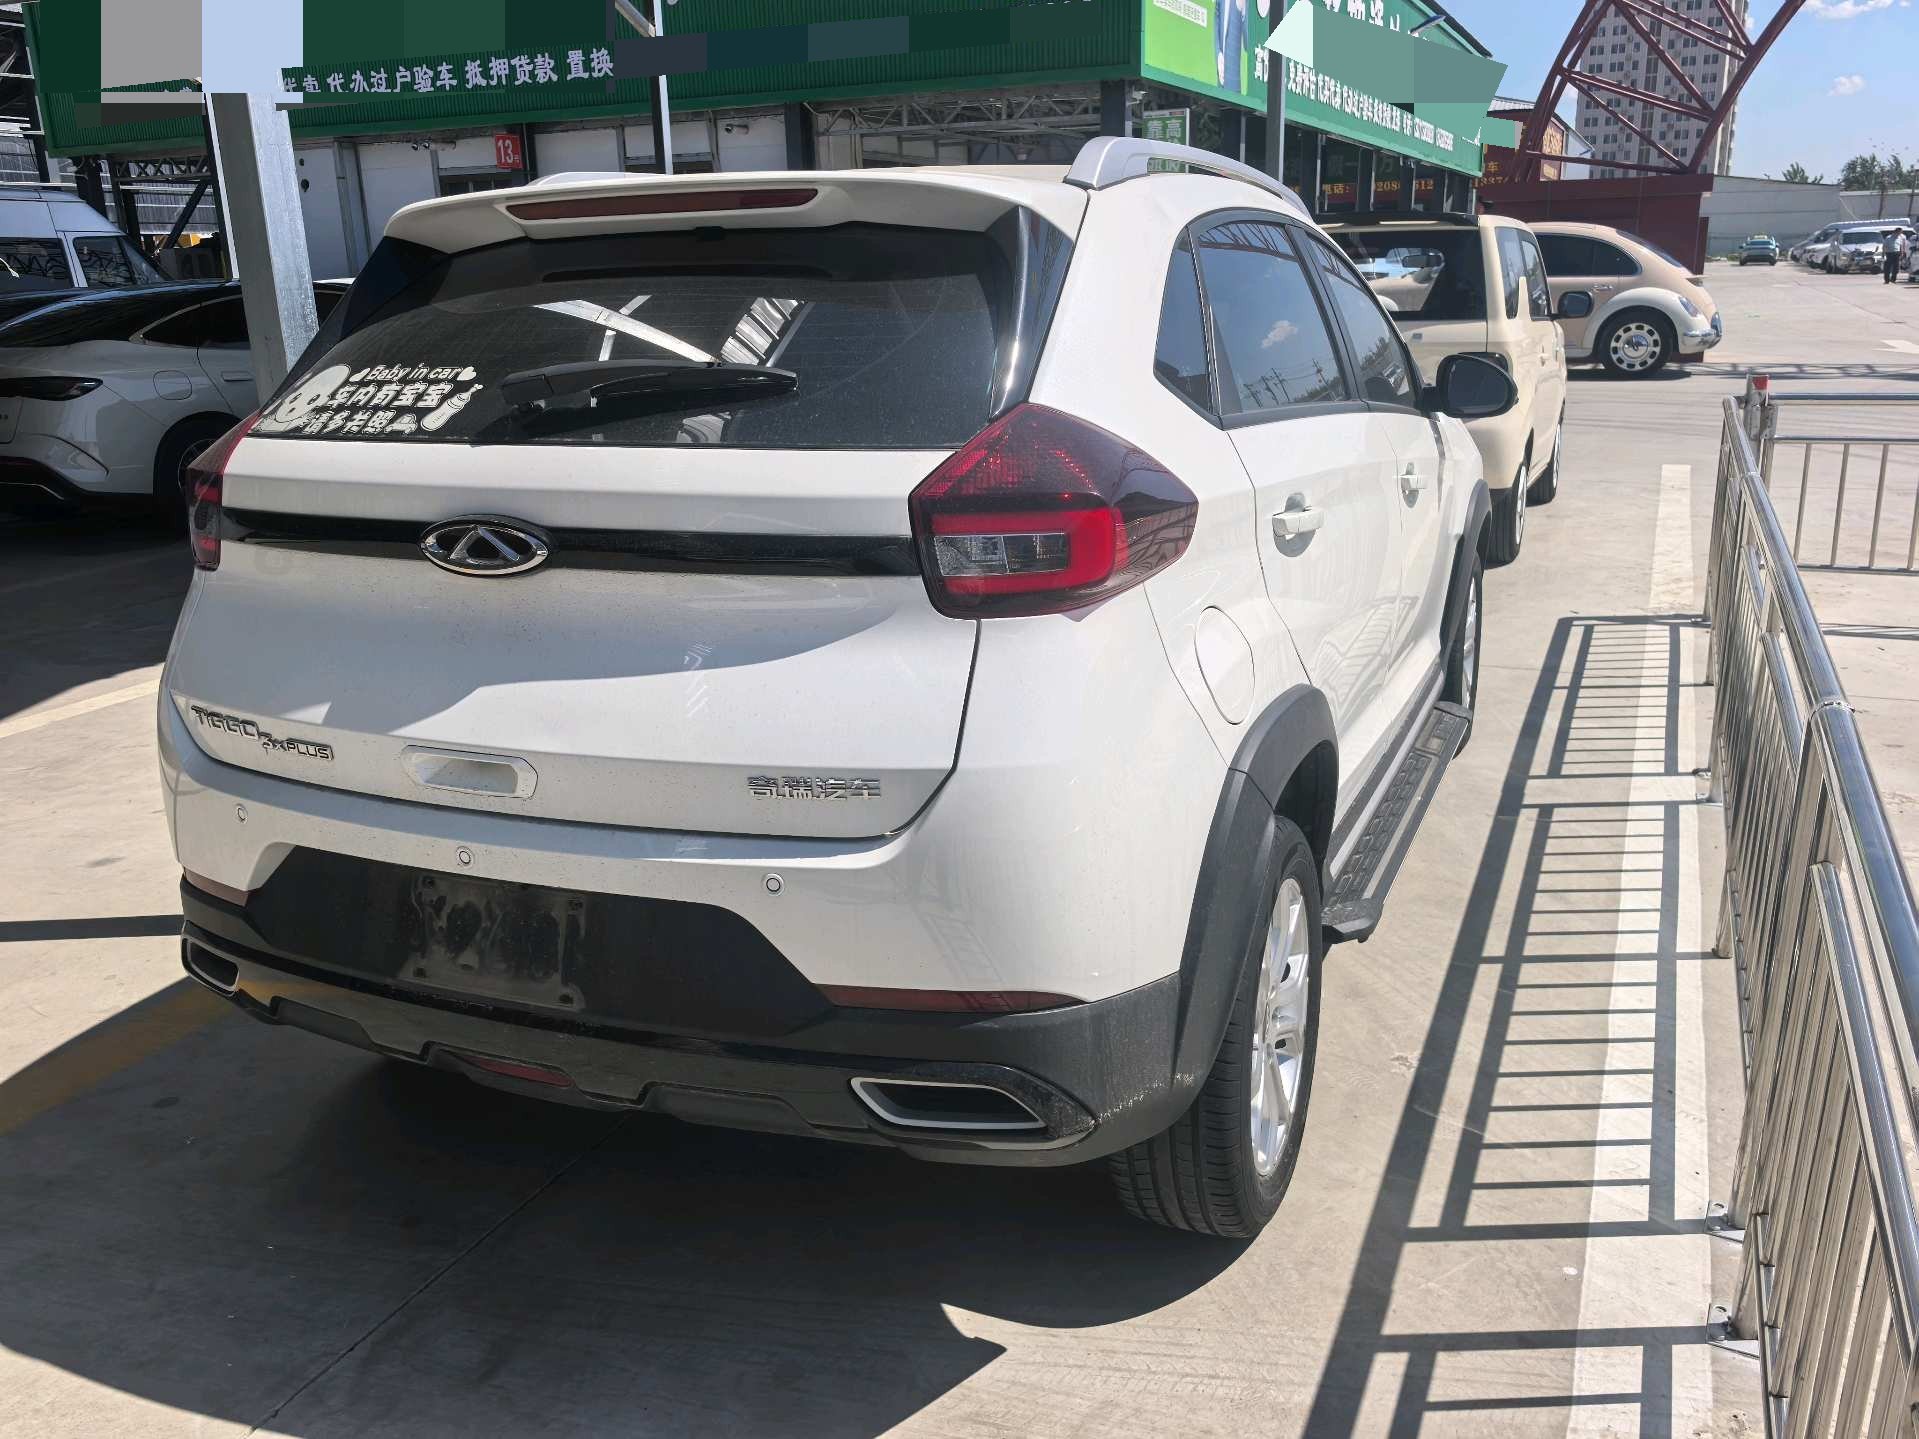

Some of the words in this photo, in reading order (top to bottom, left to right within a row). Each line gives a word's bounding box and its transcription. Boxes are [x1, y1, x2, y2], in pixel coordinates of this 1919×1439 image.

[465, 53, 558, 88] 抵押贷款
[567, 48, 614, 80] 置换
[364, 363, 411, 381] Baby
[407, 362, 429, 379] in
[429, 366, 463, 380] car
[748, 776, 881, 801] 奇瑞汽车
